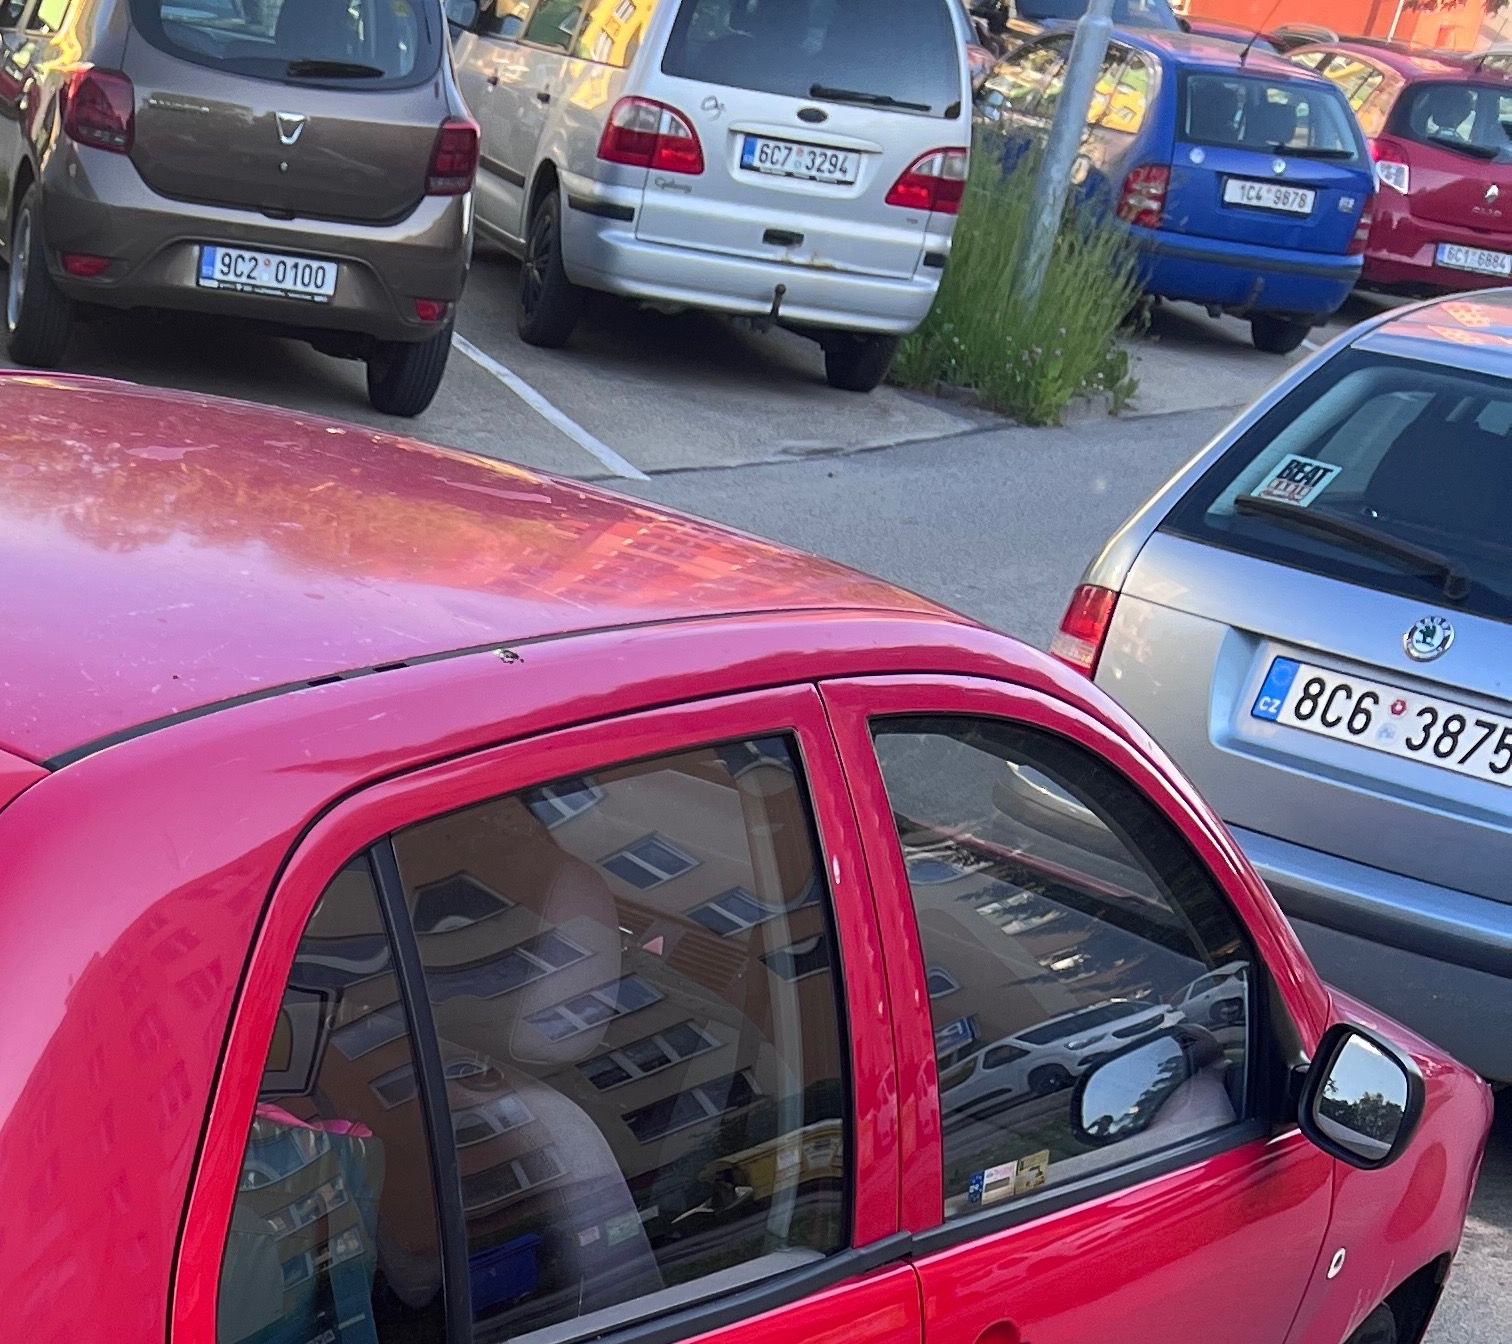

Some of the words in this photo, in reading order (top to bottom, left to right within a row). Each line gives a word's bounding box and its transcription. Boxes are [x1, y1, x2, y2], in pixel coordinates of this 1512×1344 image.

[758, 142, 793, 167] 6C7
[805, 150, 849, 176] 3294
[220, 252, 258, 281] 9C2
[275, 260, 326, 290] 0100
[1259, 696, 1279, 713] CZ
[1294, 677, 1380, 735] 8C6
[1405, 706, 1512, 774] 3875
